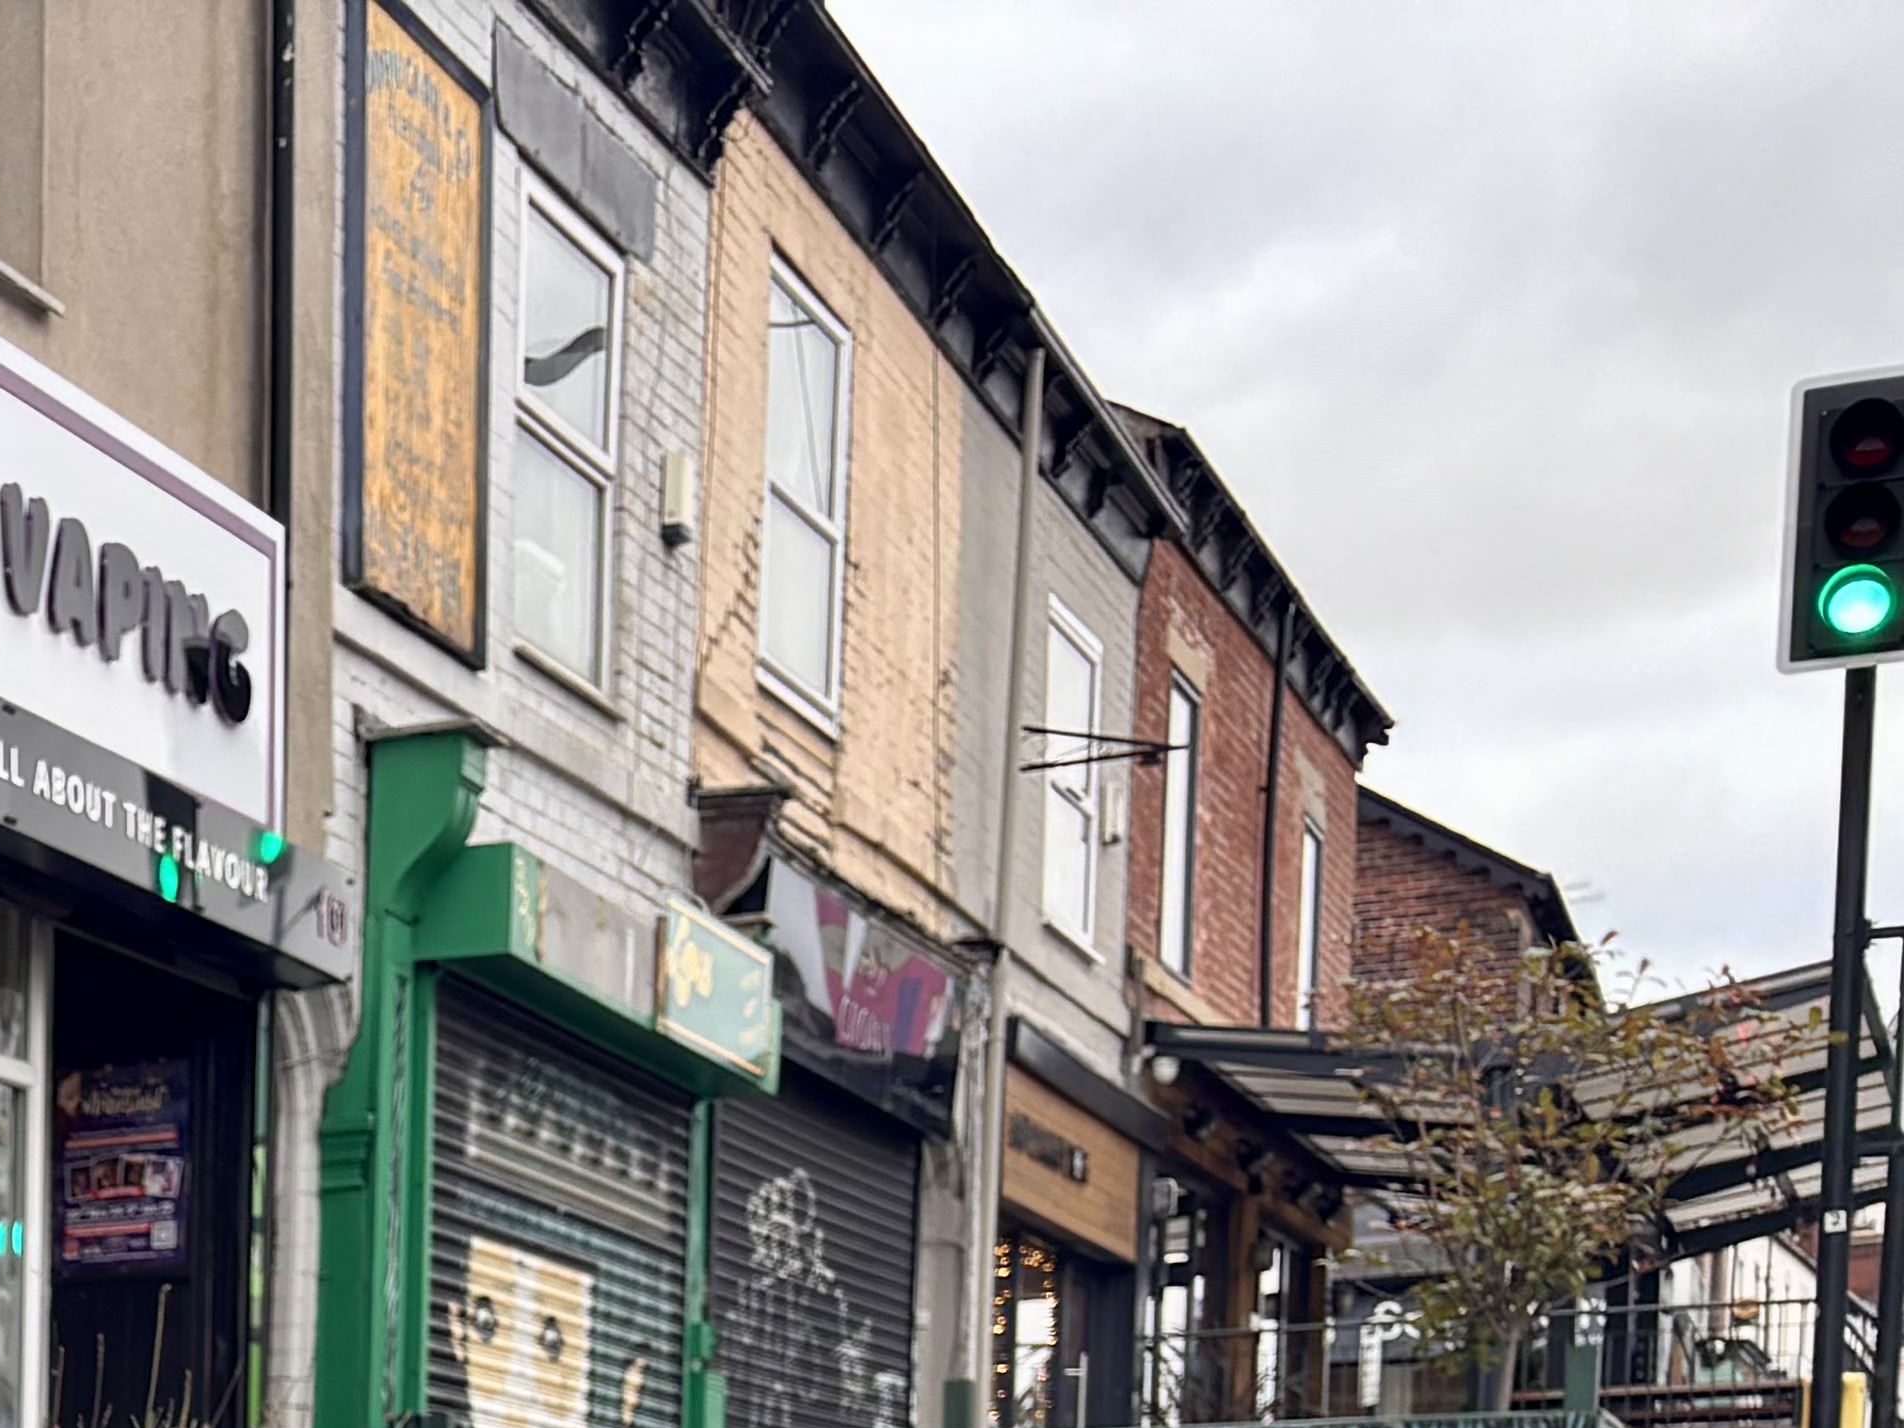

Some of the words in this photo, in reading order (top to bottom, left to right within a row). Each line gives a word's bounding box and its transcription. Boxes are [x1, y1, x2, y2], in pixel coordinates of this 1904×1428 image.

[0, 482, 252, 724] VAPING
[32, 758, 117, 829] ABOUT
[123, 801, 168, 853] THE
[170, 825, 270, 903] FLAVOUR
